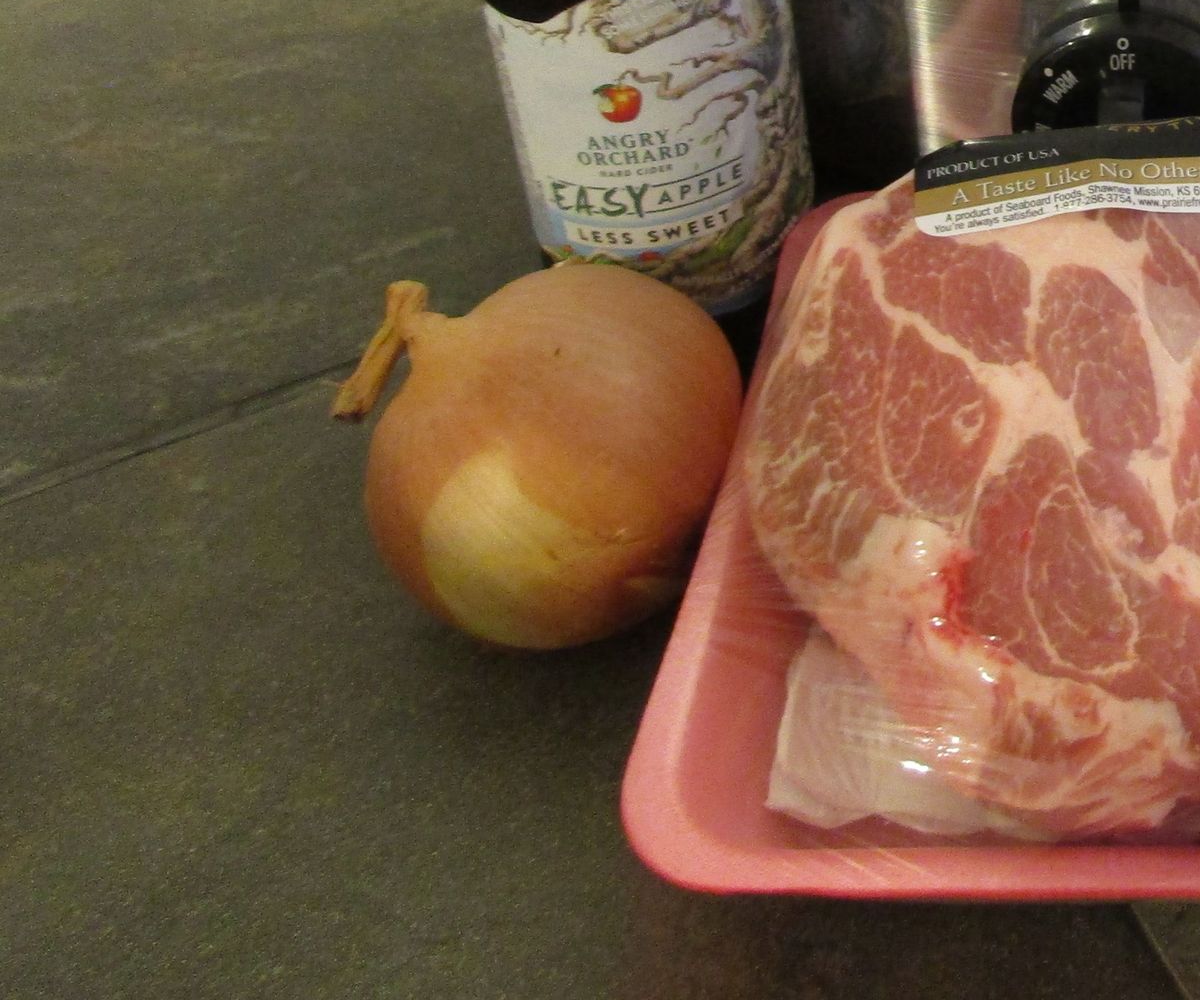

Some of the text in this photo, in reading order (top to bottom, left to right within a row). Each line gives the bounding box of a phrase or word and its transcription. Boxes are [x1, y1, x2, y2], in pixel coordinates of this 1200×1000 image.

[1110, 53, 1135, 71] OFF
[1042, 70, 1080, 104] WARM
[577, 142, 689, 166] ORCHARD
[588, 129, 669, 150] ANGRY
[636, 163, 673, 176] CIDER
[927, 148, 1061, 180] PRODUCT OF USA
[551, 163, 743, 218] EASY APPLE
[952, 188, 970, 206] A
[976, 177, 1037, 200] Taste
[1044, 163, 1091, 187] Like
[1100, 163, 1133, 180] No
[945, 214, 953, 223] A
[955, 208, 992, 223] product
[994, 205, 1003, 215] of
[1006, 194, 1051, 211] Seaboard
[1088, 184, 1131, 195] Shawnee
[1177, 186, 1191, 196] KS
[577, 209, 730, 245] LESS SWEET
[967, 216, 1000, 229] always
